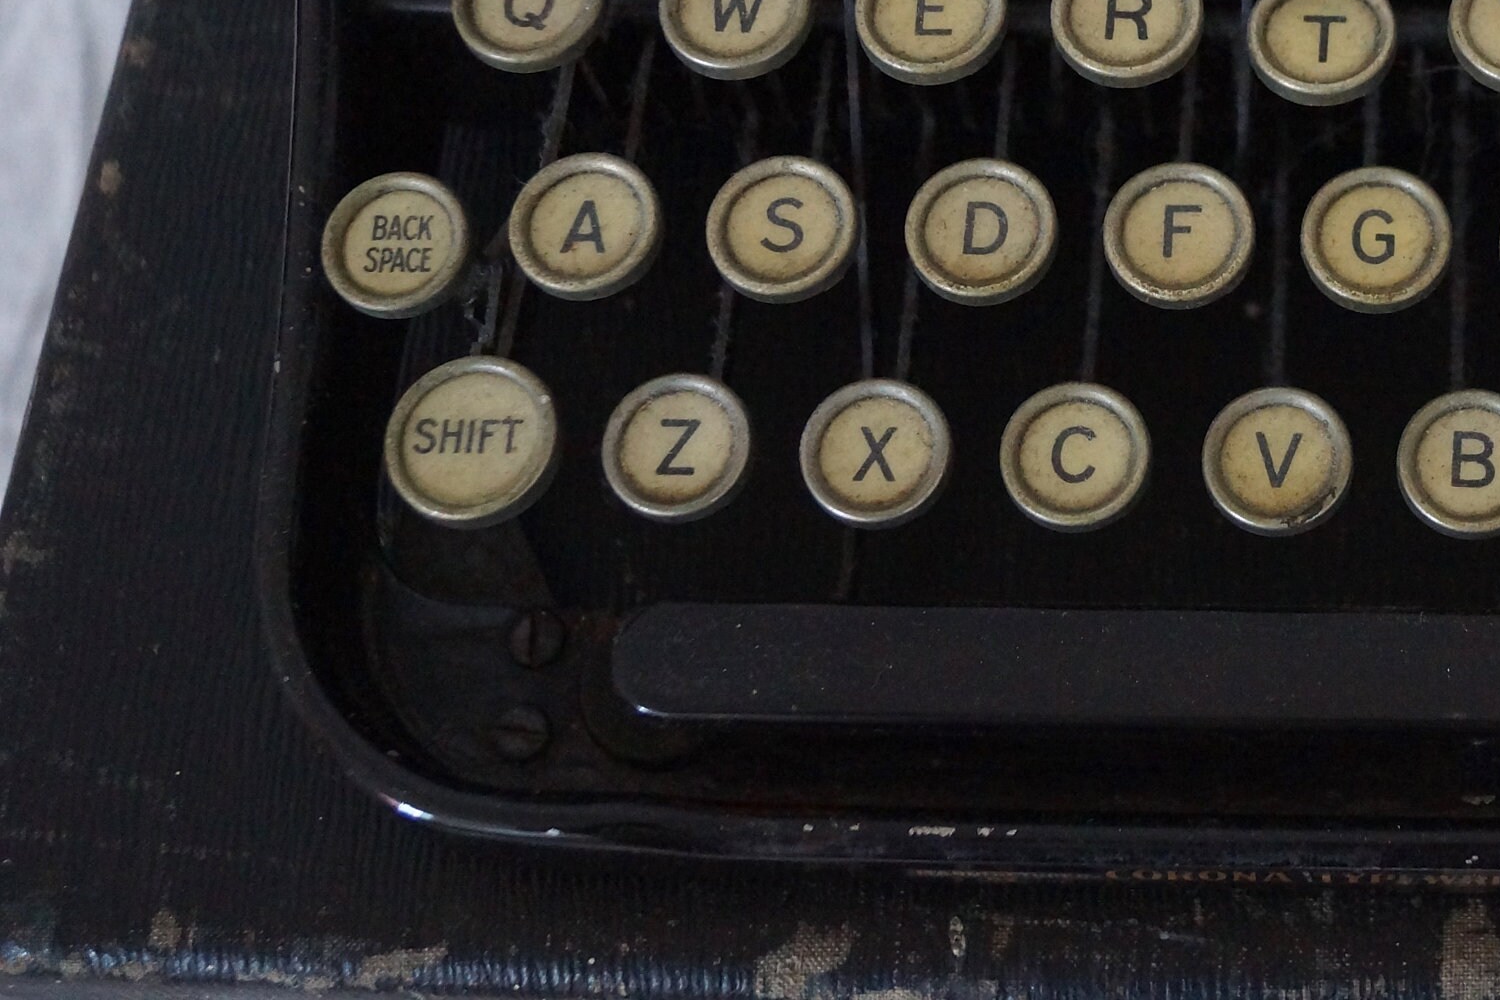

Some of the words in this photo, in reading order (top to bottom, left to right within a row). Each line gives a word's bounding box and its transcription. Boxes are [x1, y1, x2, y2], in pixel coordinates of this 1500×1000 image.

[1303, 14, 1348, 64] T
[371, 214, 434, 241] BACK
[559, 199, 606, 254] A
[760, 197, 804, 254] S
[962, 201, 1009, 256] D
[1162, 204, 1203, 259] F
[1351, 208, 1396, 265] G
[363, 246, 433, 274] SPACE
[412, 415, 525, 455] SHIFT
[655, 418, 702, 476] Z
[852, 426, 898, 482] X
[1050, 425, 1097, 484] C
[1255, 431, 1303, 489] V
[1450, 430, 1496, 489] B
